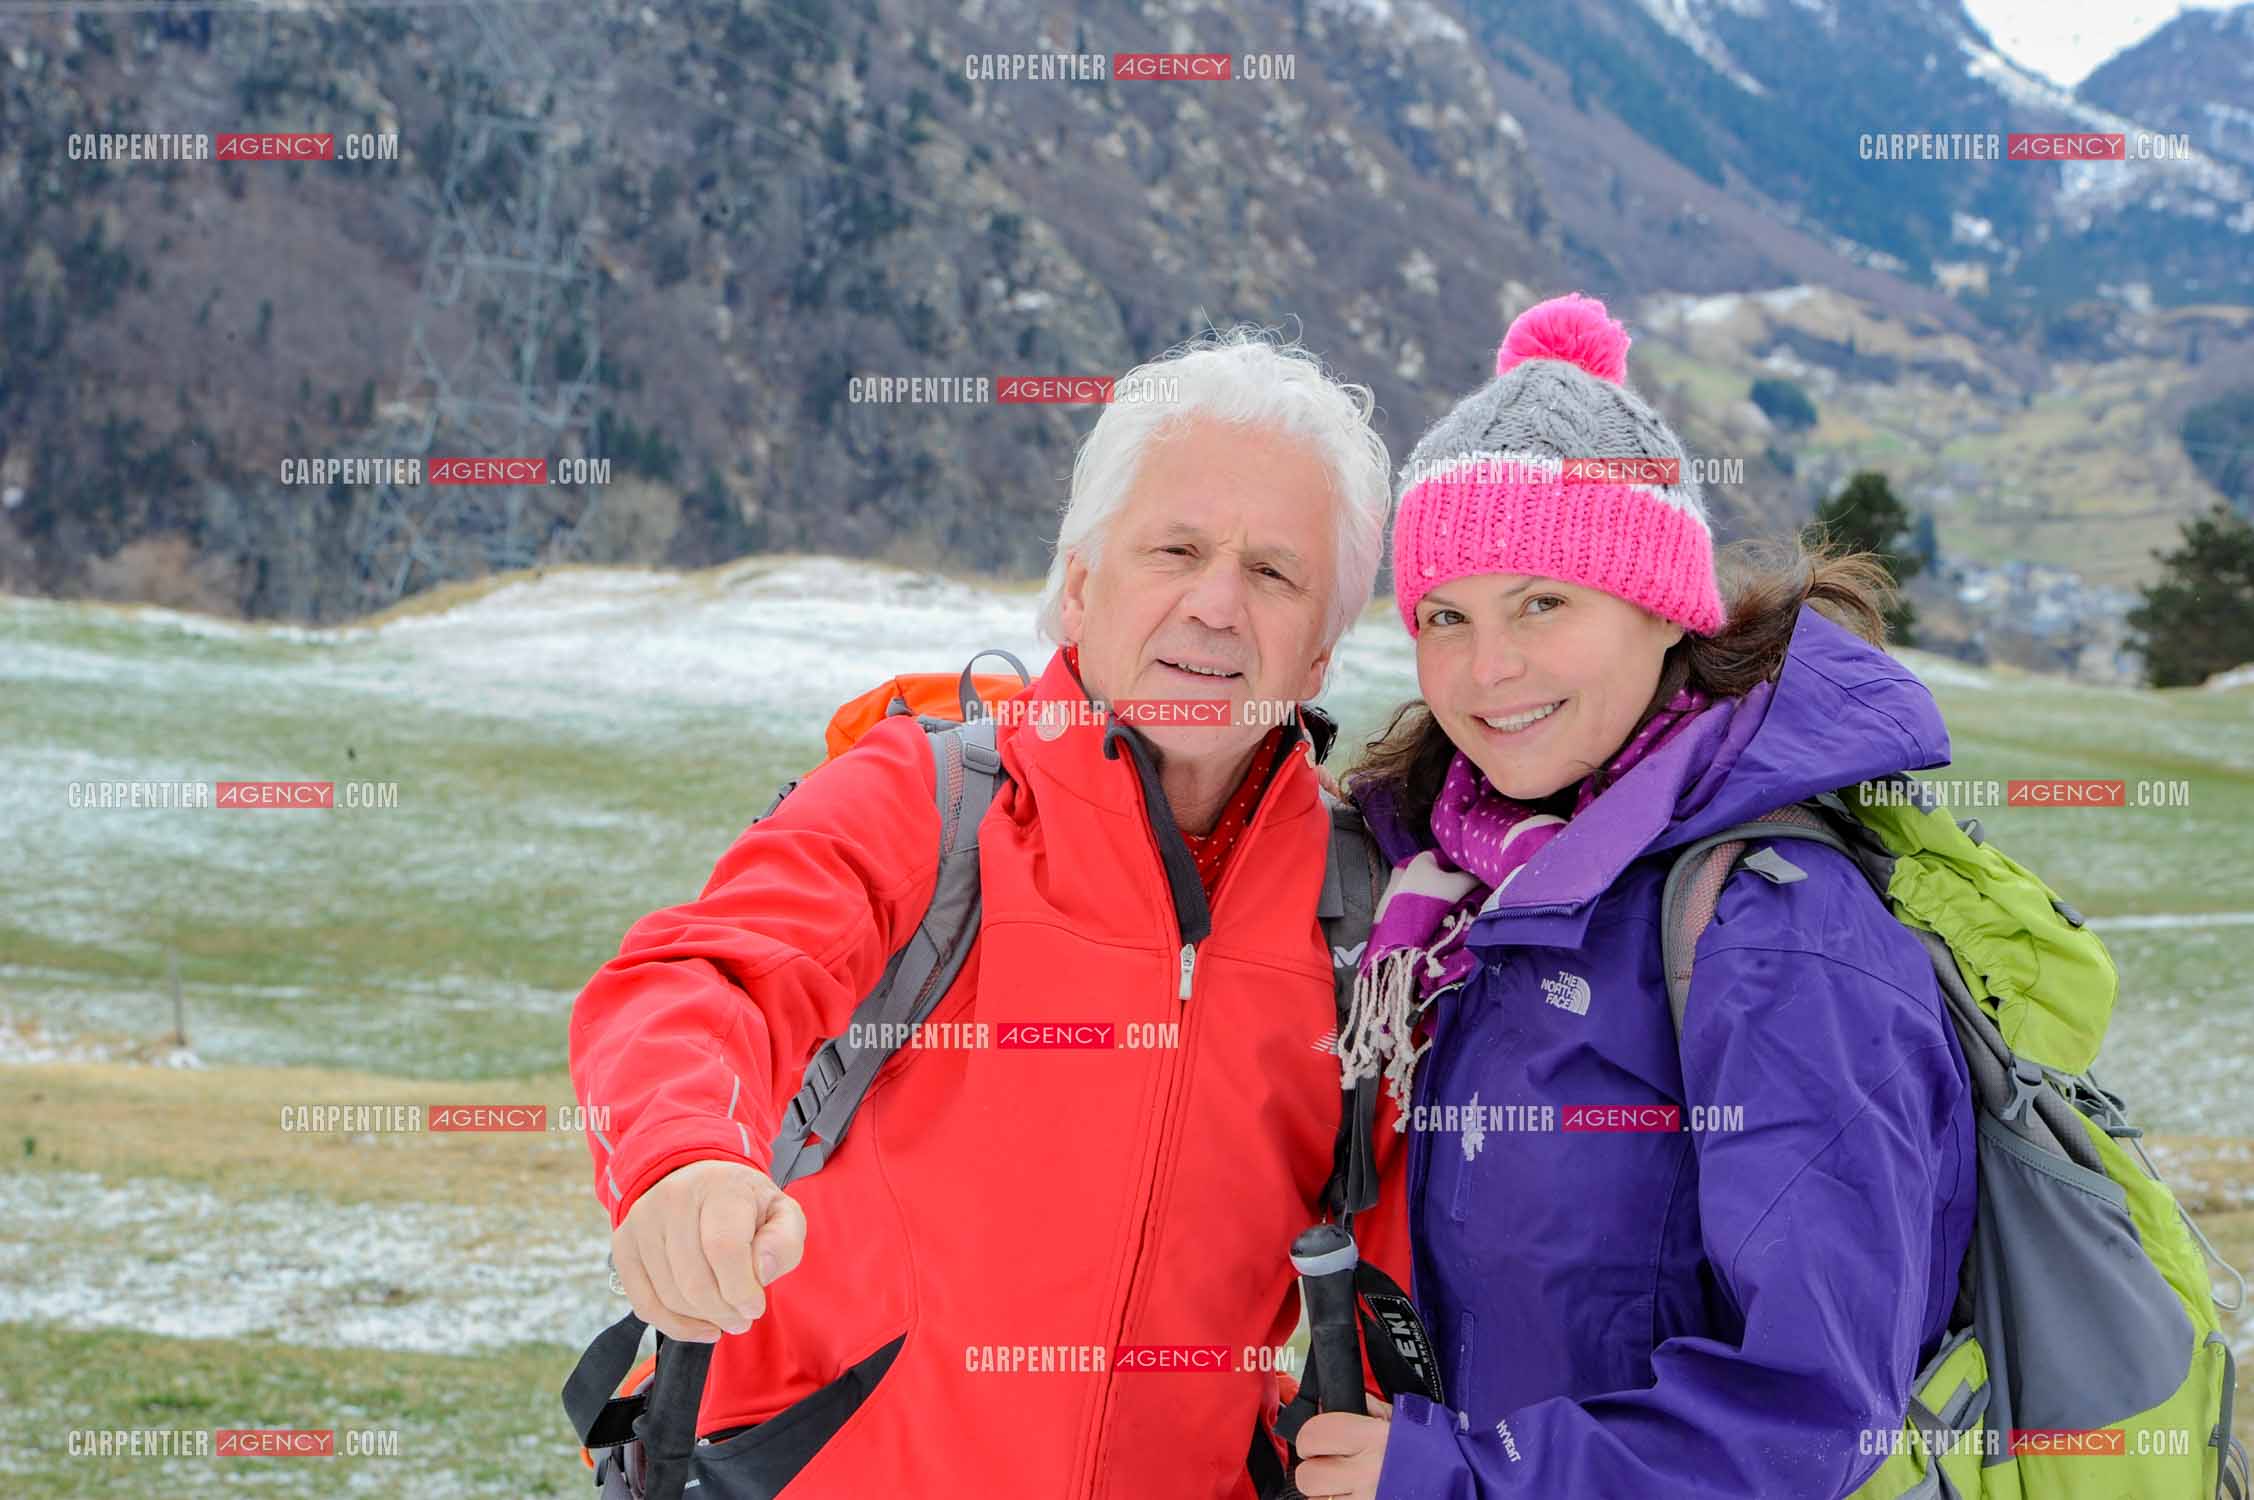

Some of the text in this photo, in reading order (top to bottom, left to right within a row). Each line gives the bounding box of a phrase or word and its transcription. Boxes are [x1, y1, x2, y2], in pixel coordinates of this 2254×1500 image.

[1558, 970, 1578, 987] THE
[1540, 978, 1573, 998] NORTH
[1545, 992, 1572, 1008] FACE
